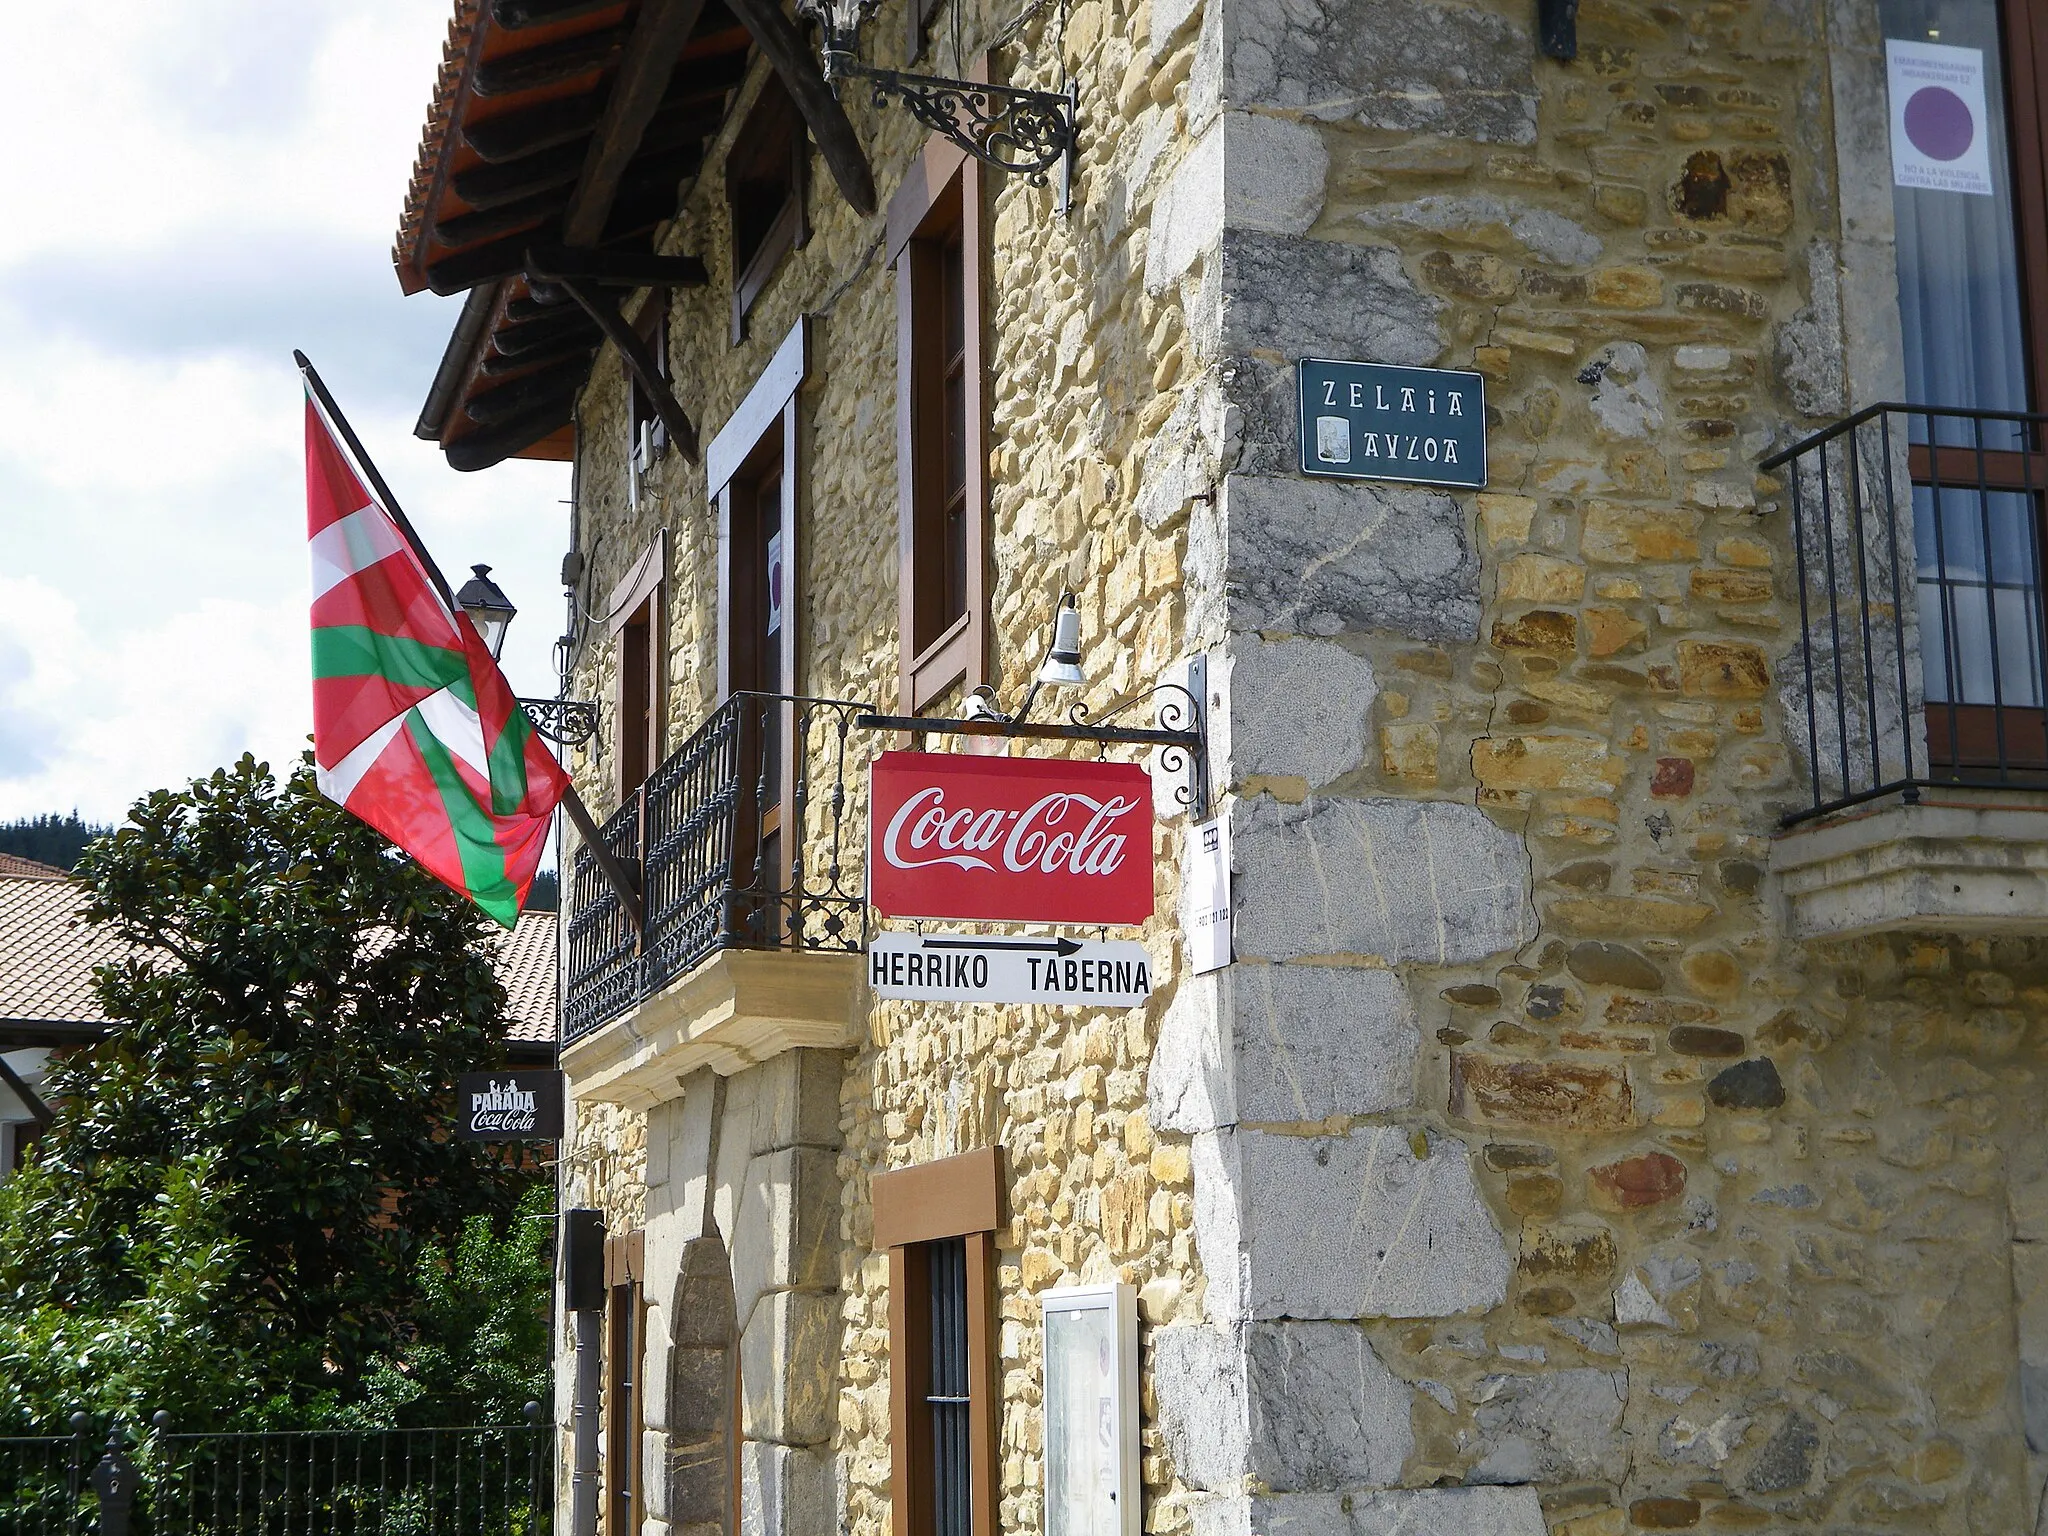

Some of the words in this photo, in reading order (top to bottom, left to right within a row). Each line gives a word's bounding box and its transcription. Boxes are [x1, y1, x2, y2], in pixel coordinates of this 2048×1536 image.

[1904, 163, 1917, 173] NO
[1926, 167, 1937, 175] LA
[1898, 173, 1931, 185] CONTRA
[1933, 178, 1949, 188] LAS
[883, 787, 1141, 877] Coca-Cola
[872, 951, 988, 988] HERRIKO
[1027, 957, 1150, 995] TABERNA
[472, 1091, 535, 1112] PARADA
